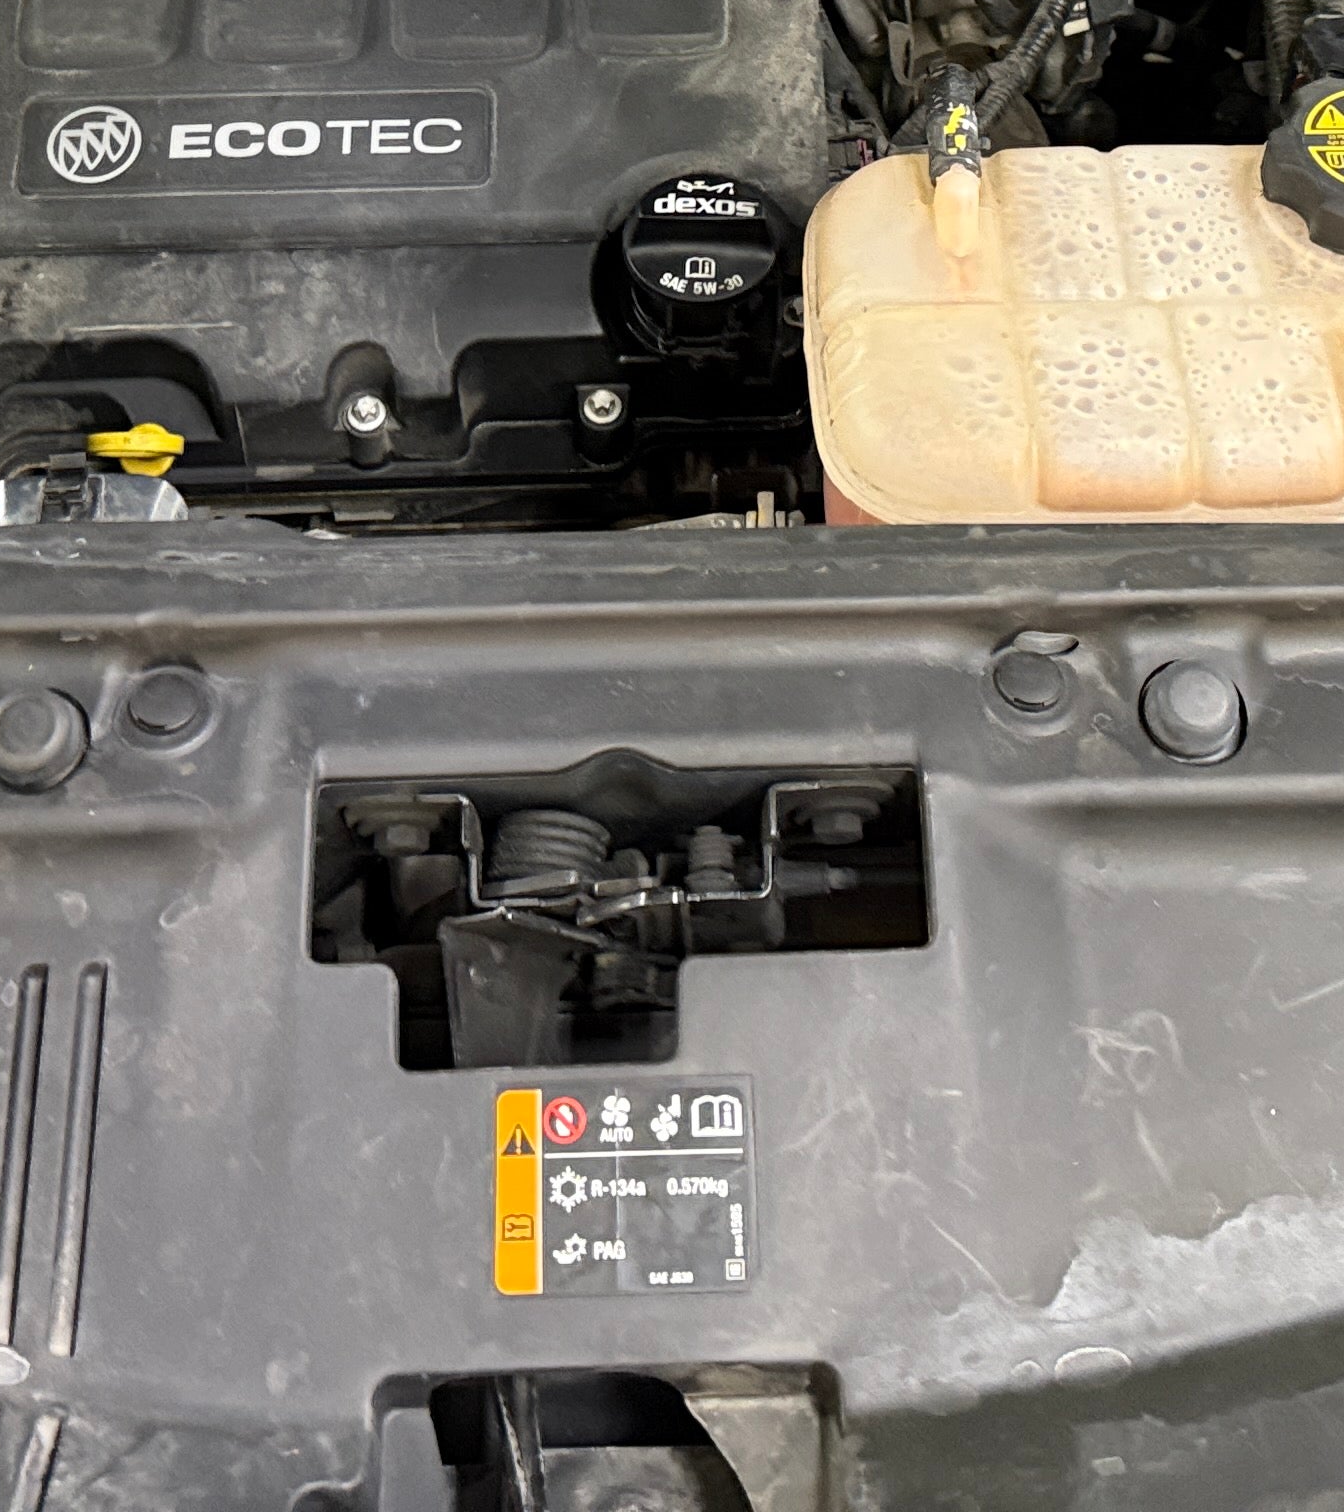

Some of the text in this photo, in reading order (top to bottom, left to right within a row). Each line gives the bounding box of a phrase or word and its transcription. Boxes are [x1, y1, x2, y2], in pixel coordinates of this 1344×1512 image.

[168, 118, 463, 160] ECOTEC
[653, 193, 760, 217] dexos
[659, 272, 744, 296] SAE 5W-30
[599, 1127, 634, 1143] AUTO
[590, 1176, 730, 1198] R-134a 0.570kg
[593, 1239, 627, 1261] PAG
